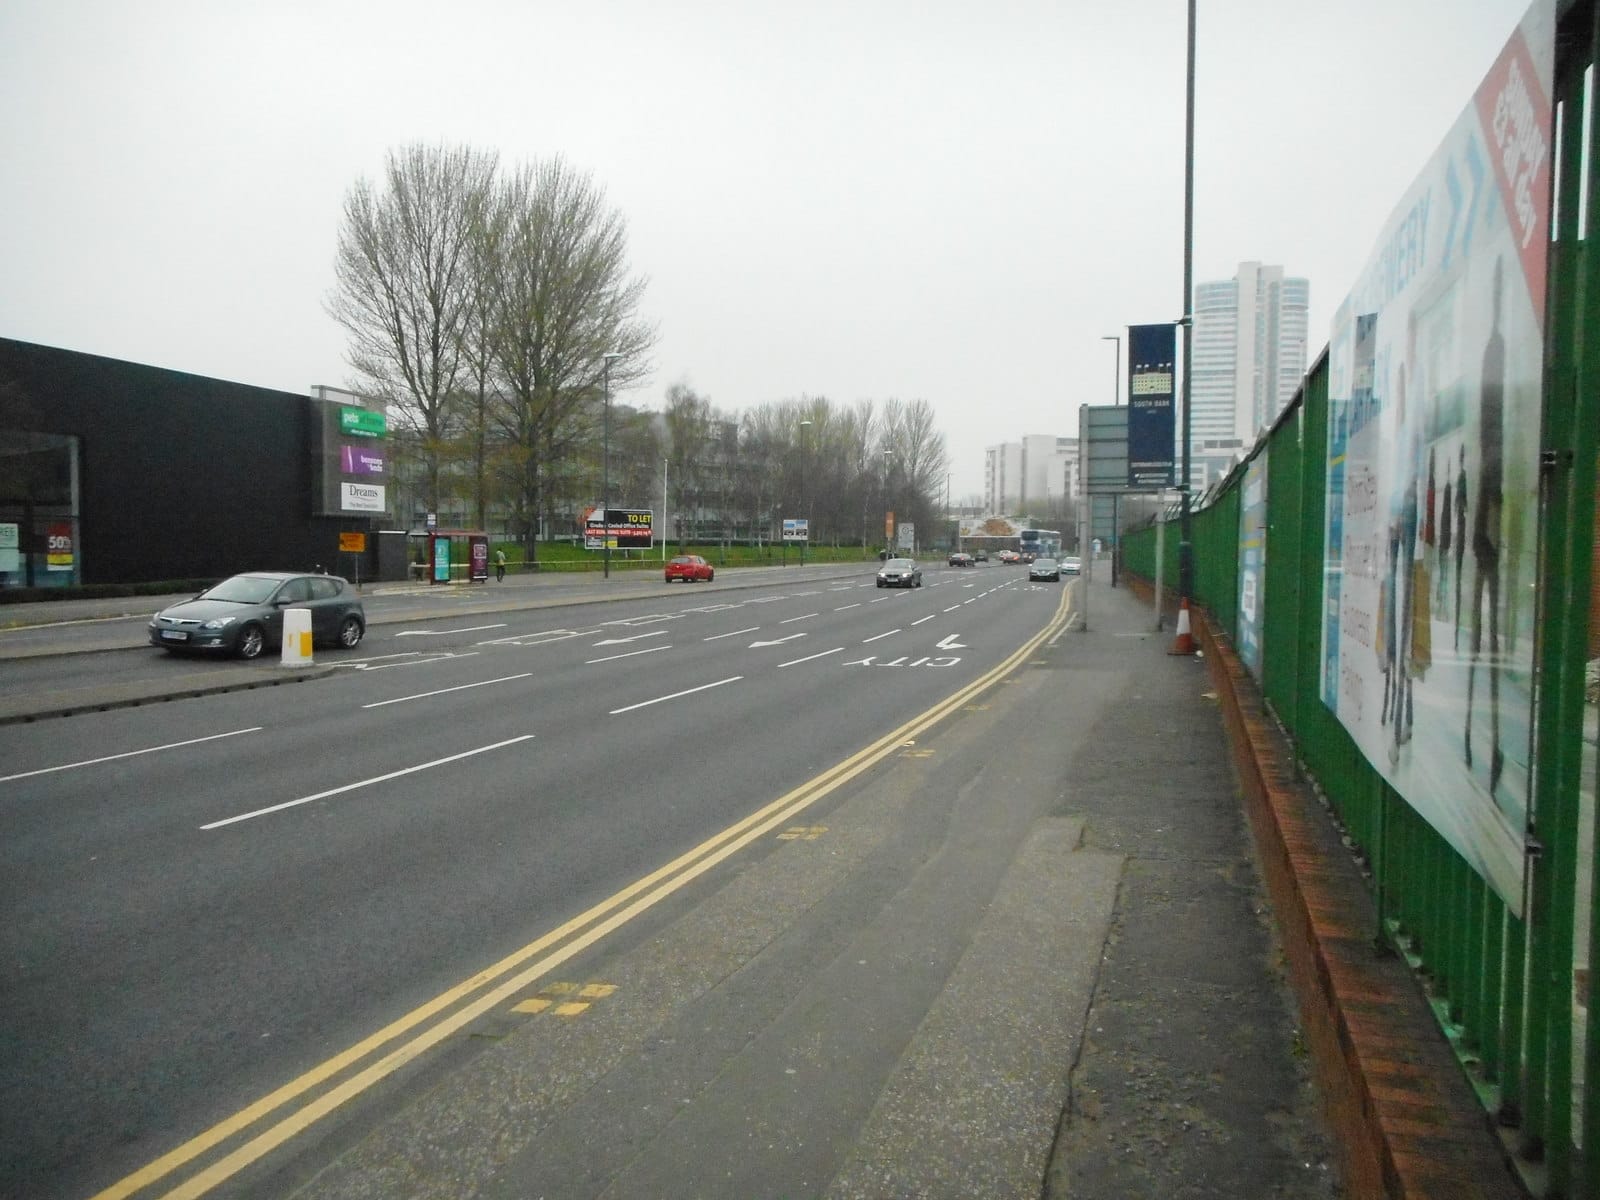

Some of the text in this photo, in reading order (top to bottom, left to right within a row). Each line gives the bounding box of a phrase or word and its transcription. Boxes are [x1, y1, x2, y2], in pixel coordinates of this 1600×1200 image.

[349, 485, 378, 497] Dreams
[627, 514, 651, 523] TO LET
[842, 656, 962, 668] CITY
